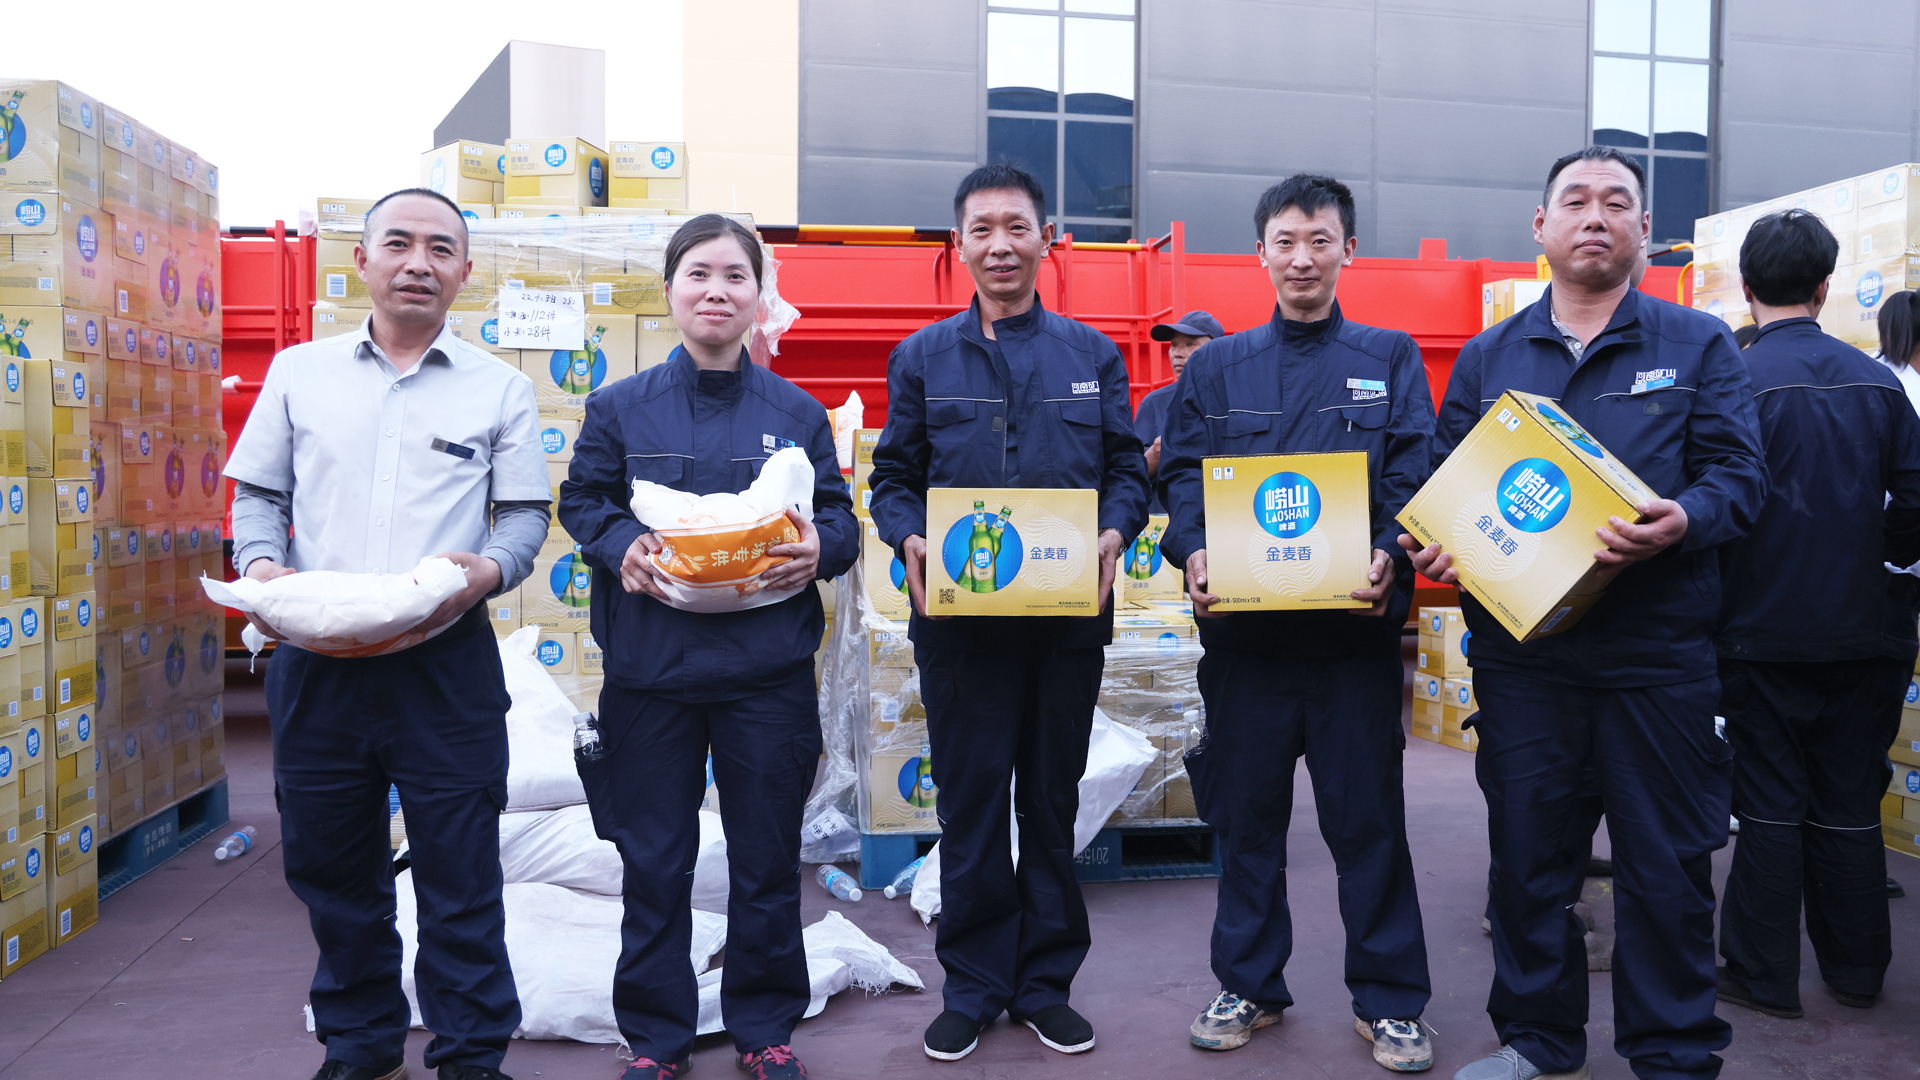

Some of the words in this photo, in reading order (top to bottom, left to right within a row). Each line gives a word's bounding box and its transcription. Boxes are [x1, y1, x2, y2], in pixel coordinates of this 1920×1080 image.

[1265, 484, 1309, 510] 崂山
[1513, 467, 1565, 512] 崂山
[1265, 506, 1310, 524] LAOSHAN
[1503, 485, 1550, 522] LAOSHAN
[1475, 514, 1520, 557] 金麦香
[1030, 547, 1068, 560] 金麦香
[1266, 546, 1312, 562] 金麦香
